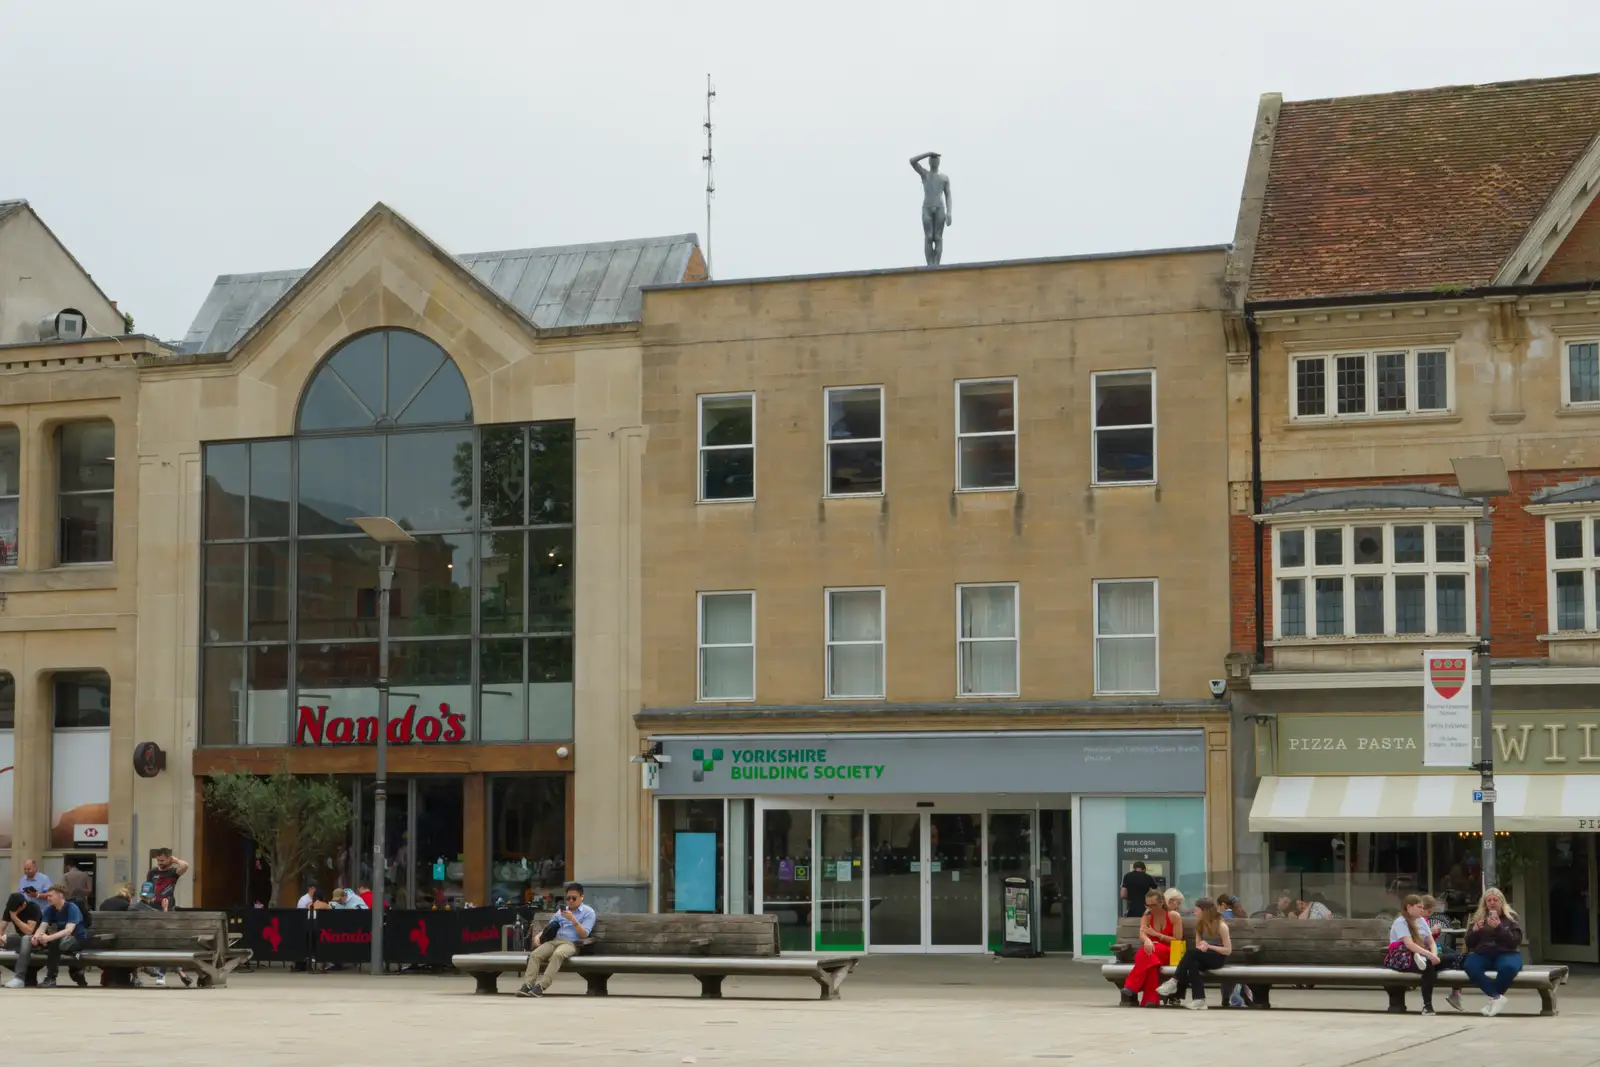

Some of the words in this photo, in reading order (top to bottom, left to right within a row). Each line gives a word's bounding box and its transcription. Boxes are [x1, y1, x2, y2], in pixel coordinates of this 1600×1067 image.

[296, 703, 466, 745] Nando's
[1289, 738, 1348, 750] PIZZA
[1358, 737, 1417, 749] PASTA
[732, 749, 827, 763] YORKSHIRE
[731, 765, 809, 779] BUILDING
[813, 765, 885, 779] SOCIETY
[1578, 819, 1600, 829] PI
[319, 927, 373, 943] Nando'
